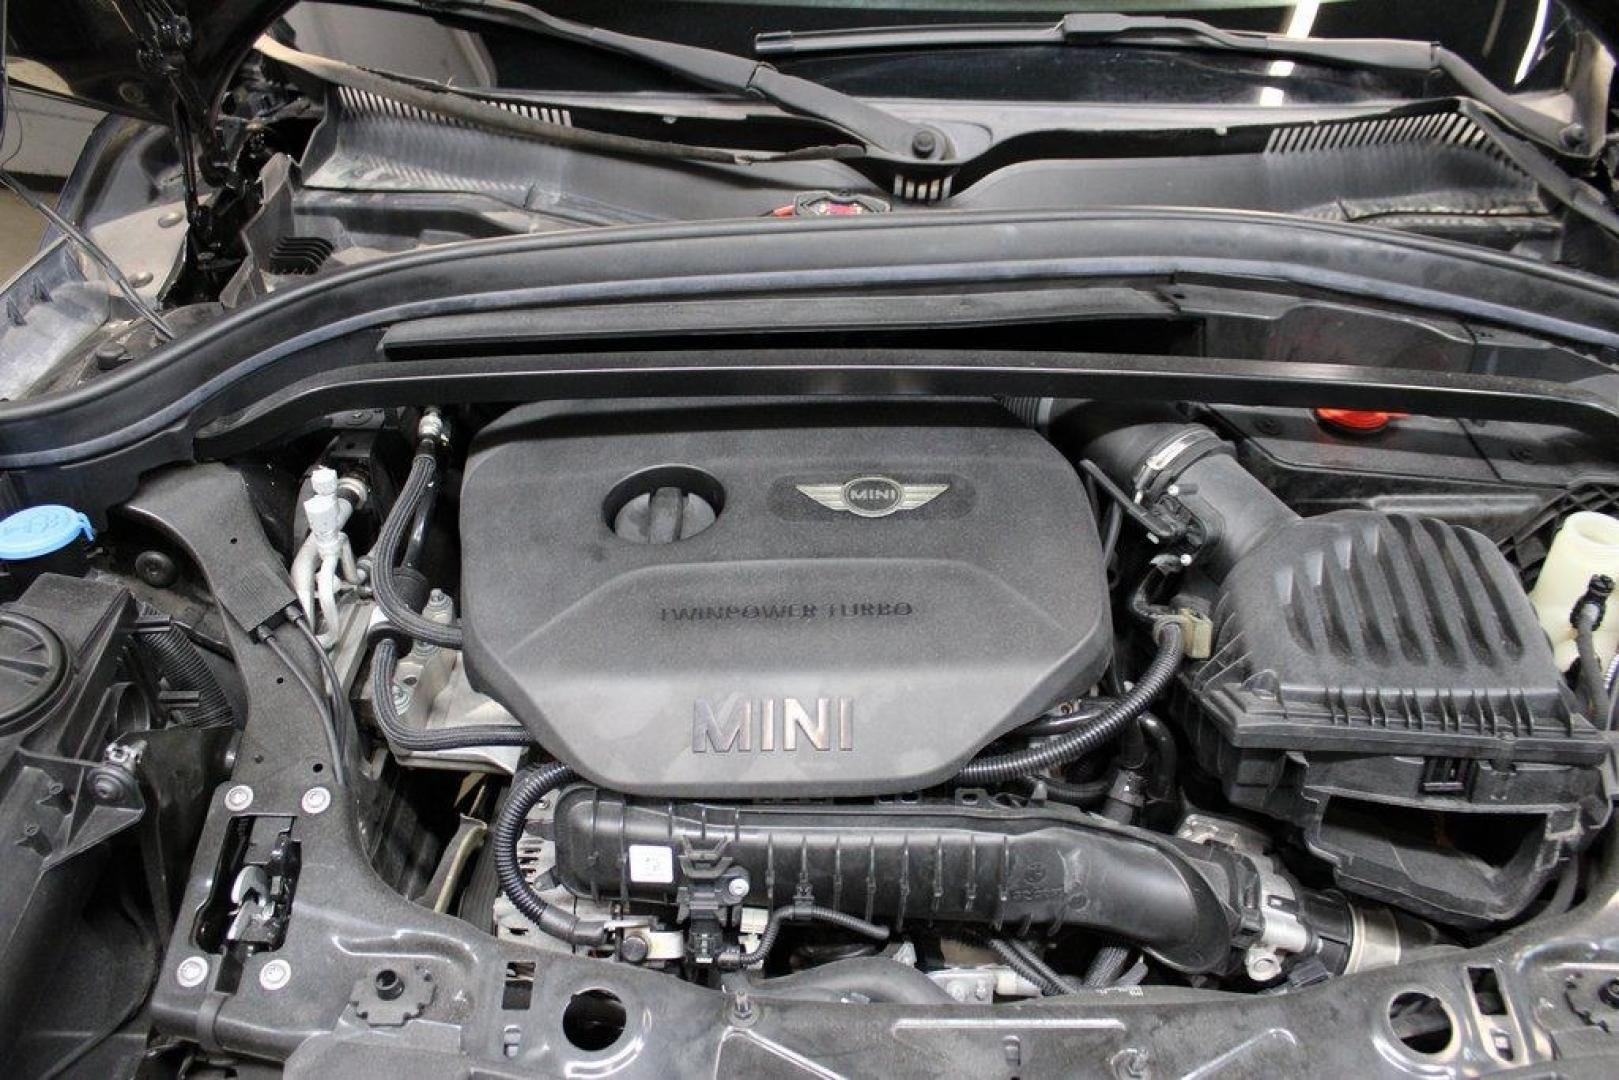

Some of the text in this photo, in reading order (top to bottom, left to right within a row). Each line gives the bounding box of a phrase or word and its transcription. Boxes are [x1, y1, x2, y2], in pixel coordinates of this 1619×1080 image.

[850, 488, 897, 500] MINI
[660, 601, 913, 621] TWINPOWER TURBO
[692, 697, 853, 753] MINI
